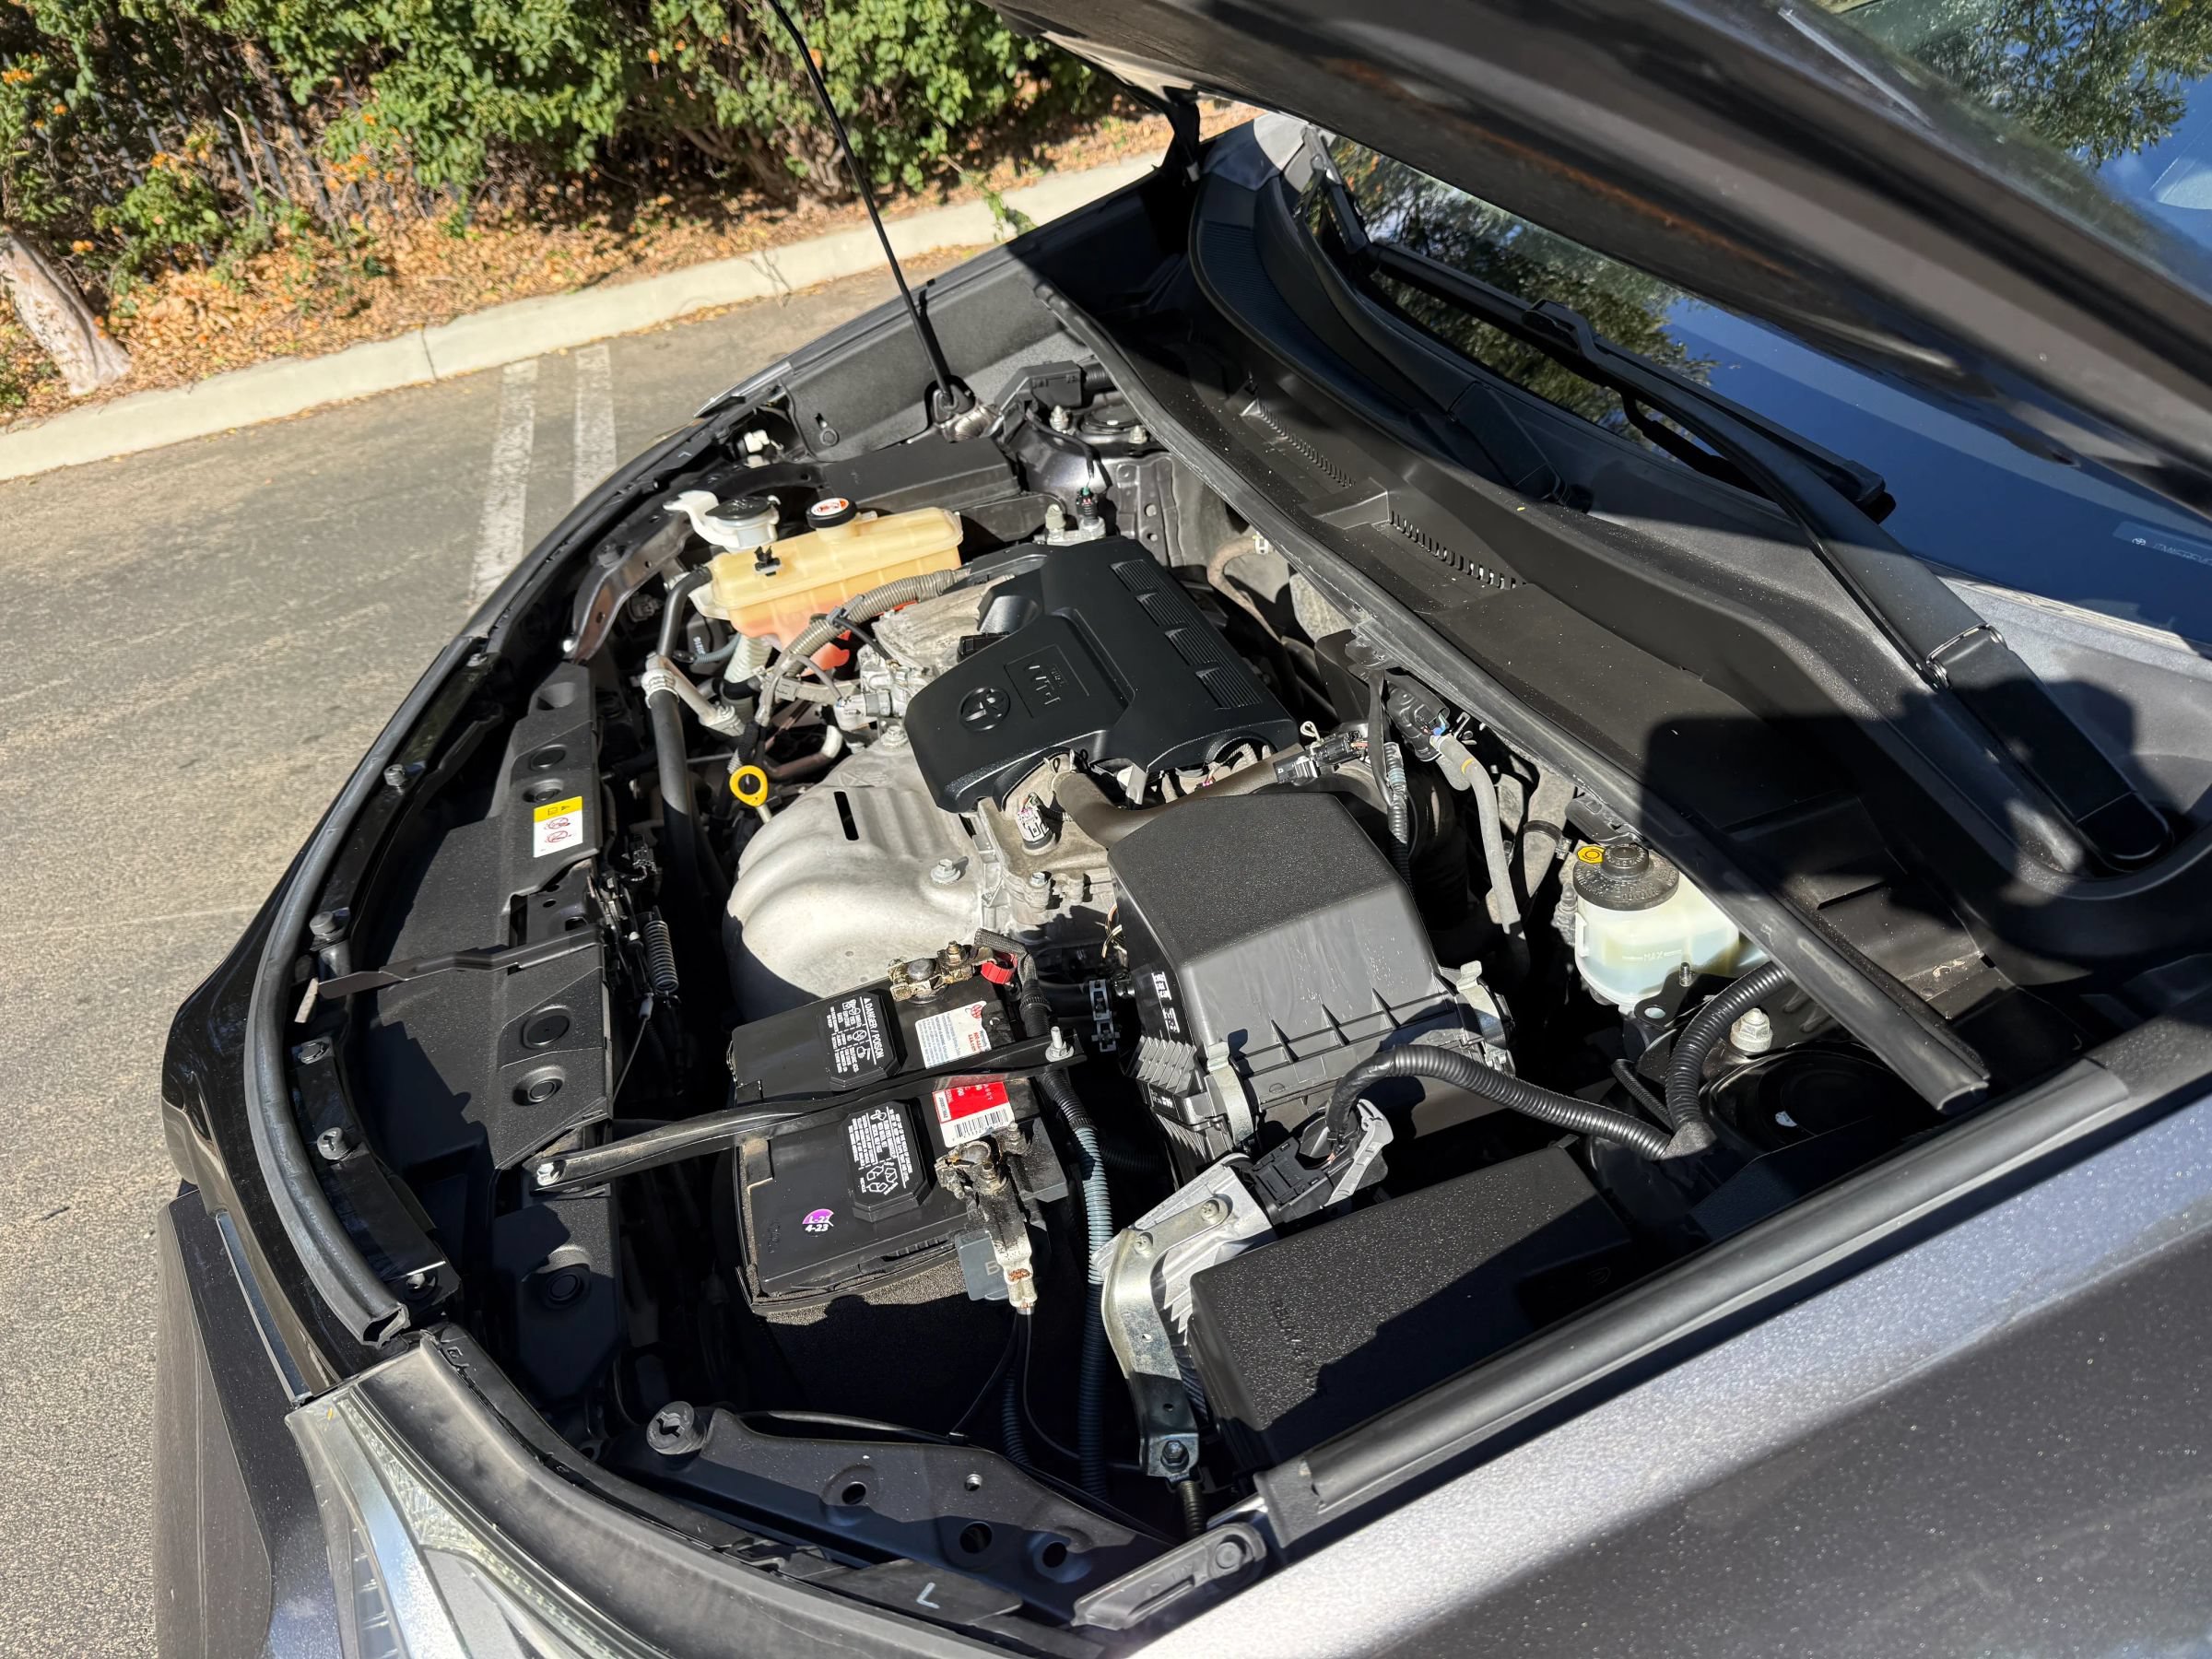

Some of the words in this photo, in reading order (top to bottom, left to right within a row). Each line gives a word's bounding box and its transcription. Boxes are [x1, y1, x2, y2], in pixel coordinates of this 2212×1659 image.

[865, 1003, 877, 1030] DANGER
[872, 1033, 884, 1059] POISON
[805, 1223, 829, 1233] 4-23
[984, 1260, 1000, 1276] B
[916, 1582, 939, 1608] L
